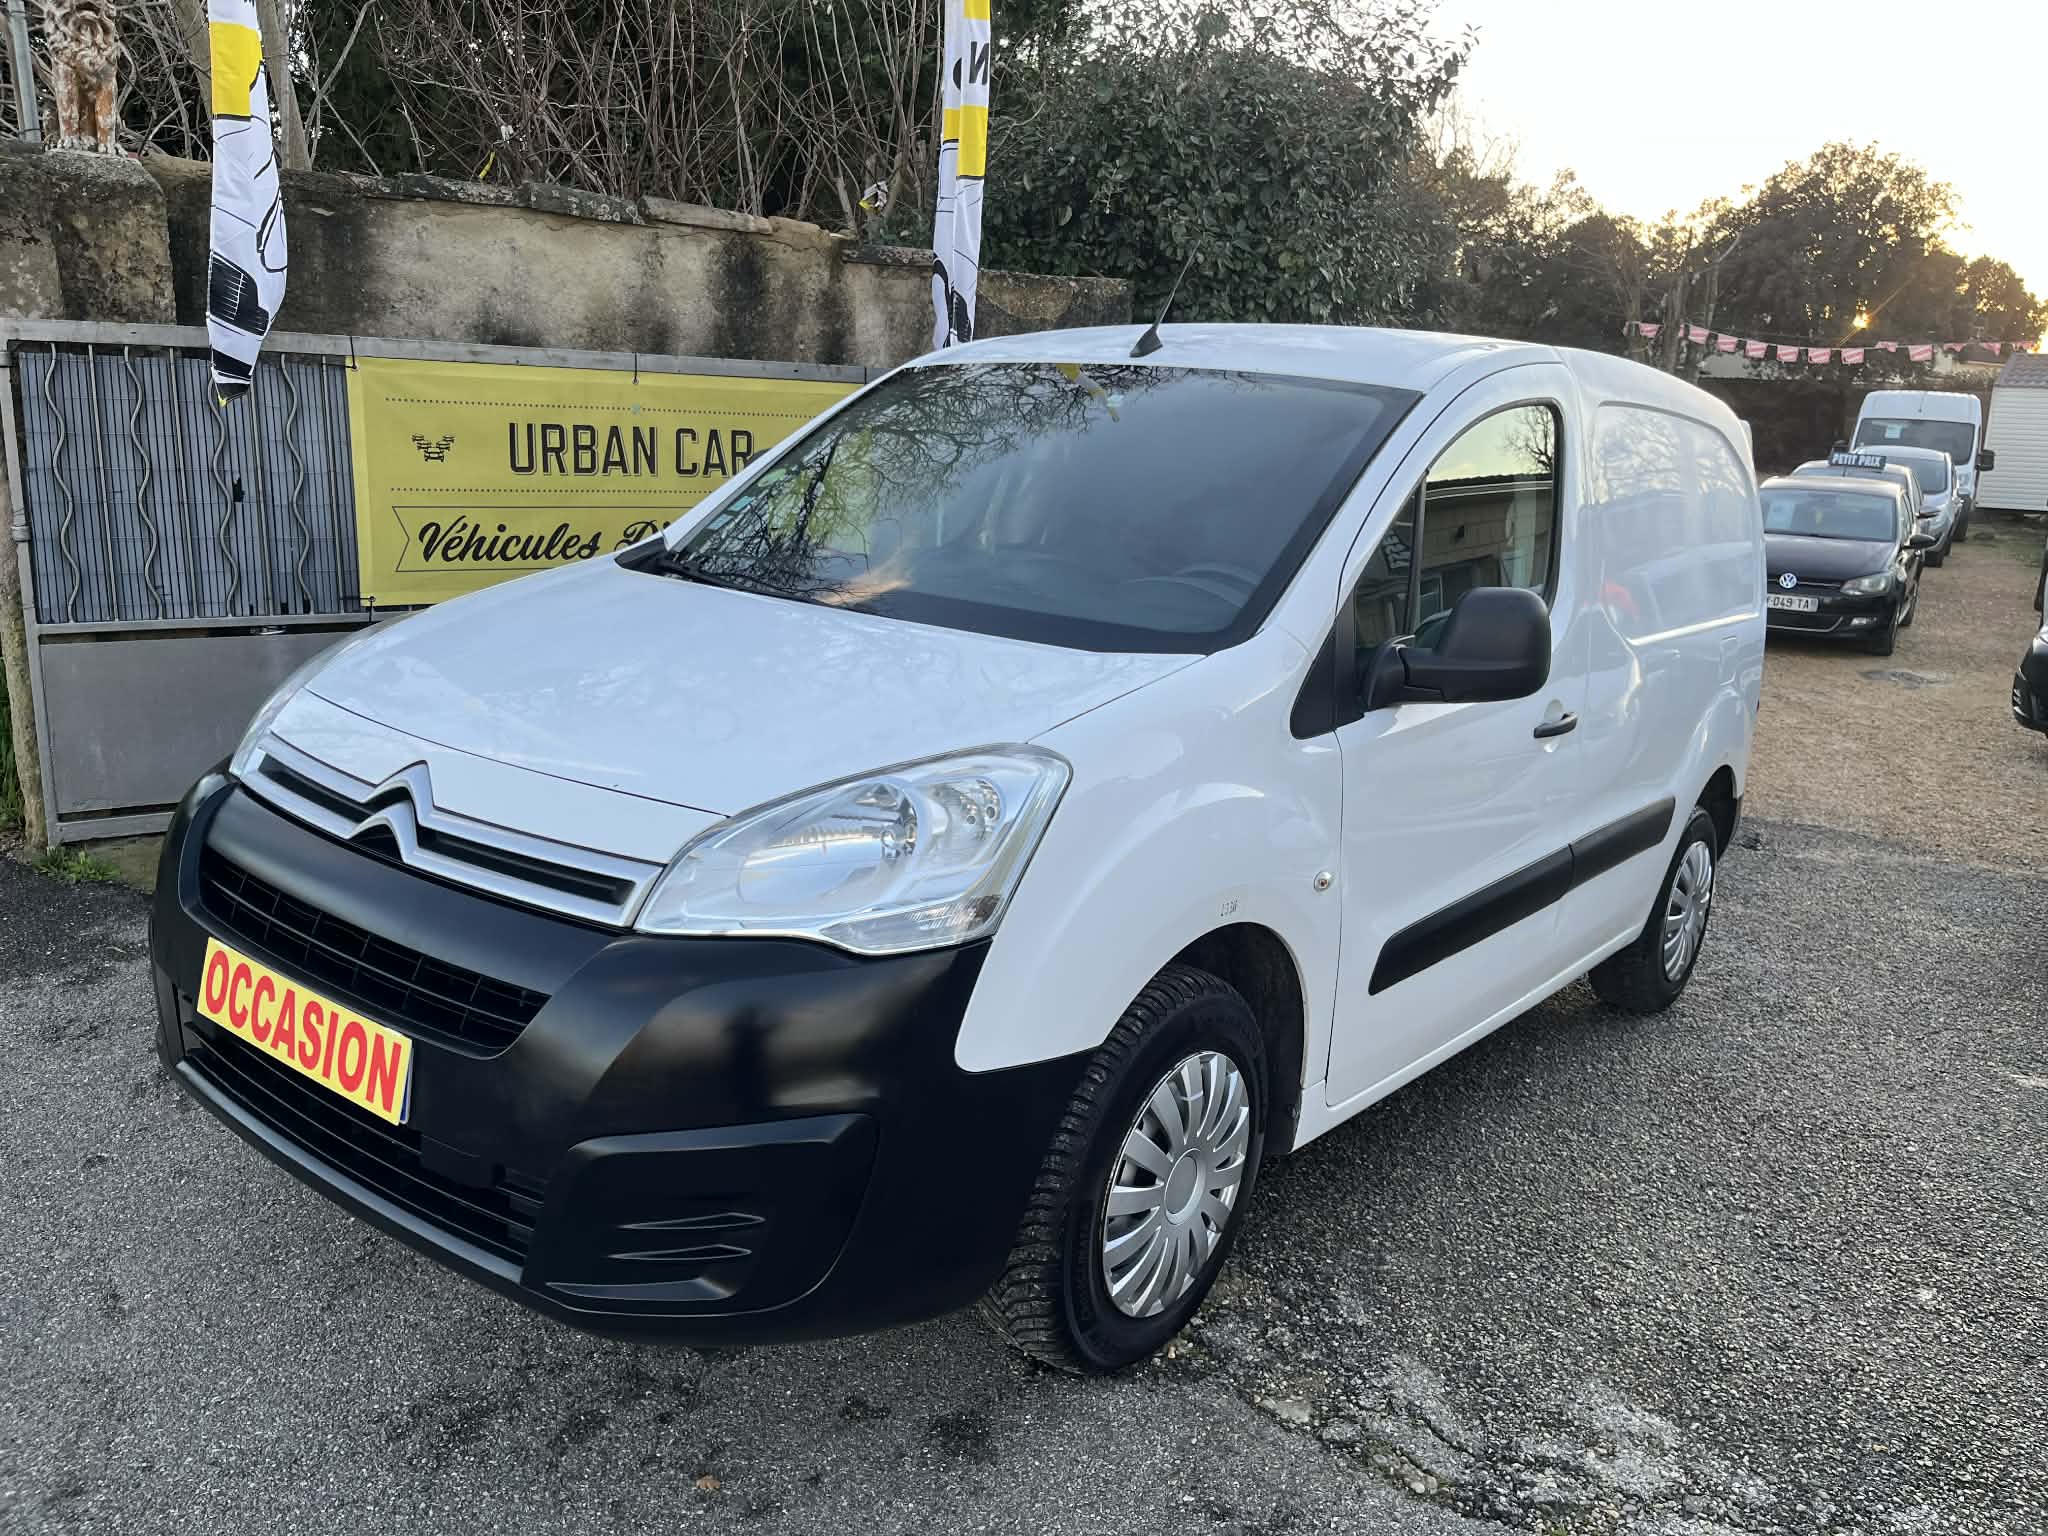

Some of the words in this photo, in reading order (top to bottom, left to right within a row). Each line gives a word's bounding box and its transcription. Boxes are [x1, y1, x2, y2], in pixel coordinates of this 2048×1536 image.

[508, 422, 657, 477] URBAN
[675, 427, 754, 478] CAR
[1831, 453, 1857, 466] PETIT
[1857, 455, 1881, 468] PRIX
[418, 515, 602, 562] Véhicules
[205, 950, 402, 1113] OCCASION
